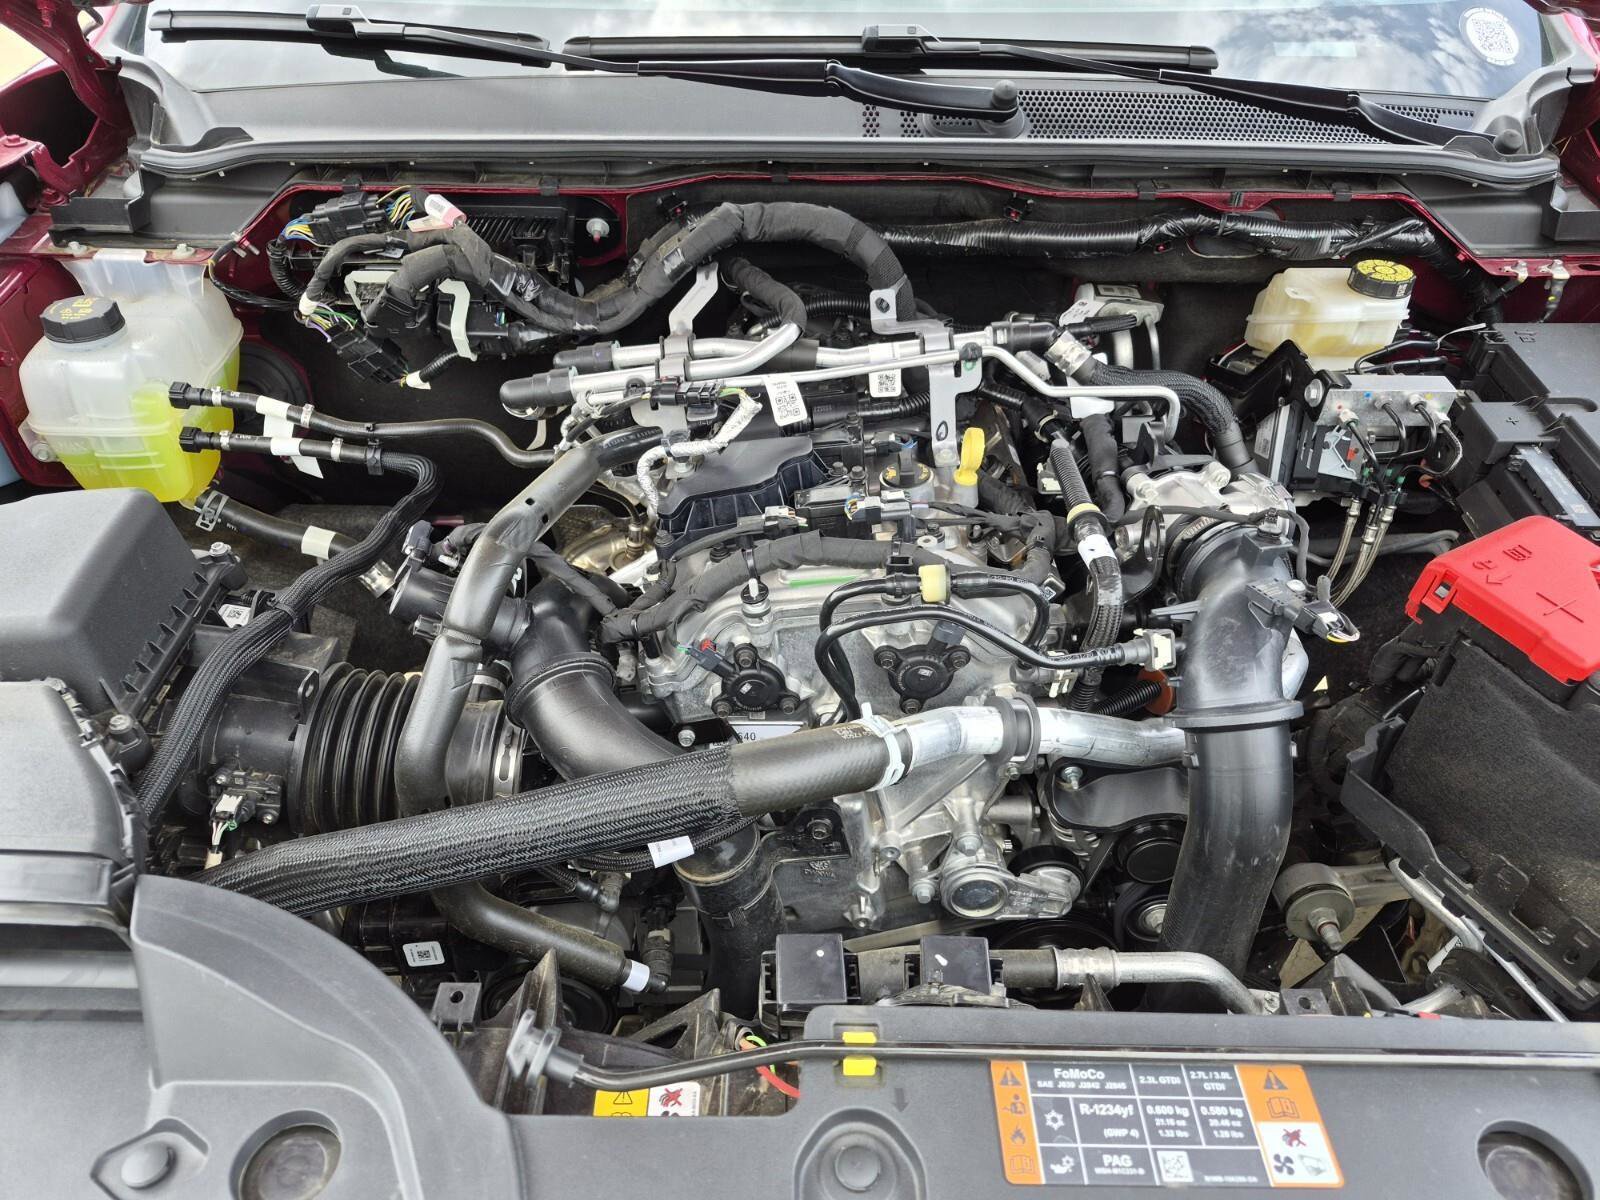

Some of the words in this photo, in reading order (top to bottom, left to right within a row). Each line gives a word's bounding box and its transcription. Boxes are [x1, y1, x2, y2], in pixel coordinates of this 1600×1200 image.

[1053, 1067, 1106, 1080] FoMoCo
[1139, 1075, 1158, 1085] 2.3L
[1158, 1076, 1182, 1085] GTDI
[1189, 1071, 1208, 1080] 2.7L
[1036, 1080, 1055, 1088] SAE
[1203, 1082, 1226, 1091] GTDI
[1079, 1102, 1134, 1119] R-1234yf
[1145, 1104, 1174, 1115] 0.600
[1174, 1105, 1190, 1118] kg
[1199, 1105, 1229, 1116] 0.580
[1229, 1105, 1244, 1118] kg
[1102, 1154, 1133, 1168] PAG
